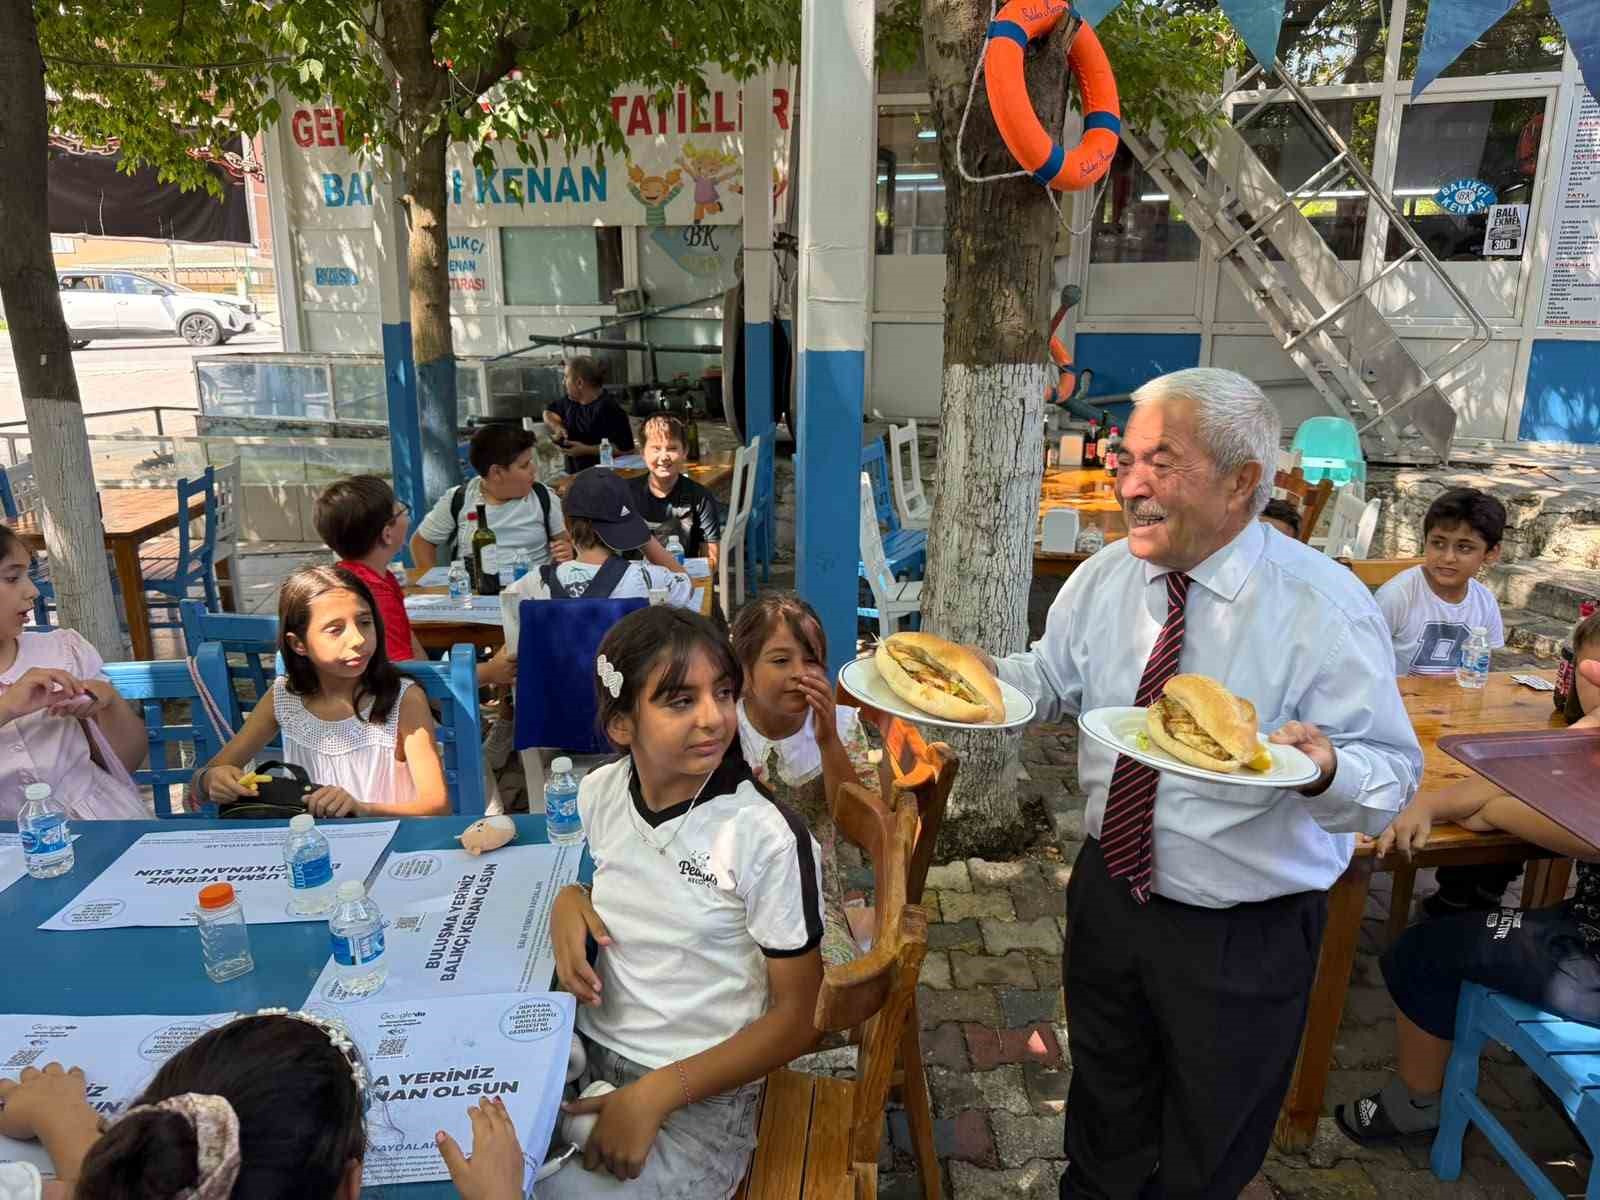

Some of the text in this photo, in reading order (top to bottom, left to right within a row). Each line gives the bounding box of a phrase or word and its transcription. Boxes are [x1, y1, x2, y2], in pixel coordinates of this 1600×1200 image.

[474, 166, 607, 204] KENAN
[1442, 198, 1485, 214] KENAN
[1493, 239, 1511, 250] 300
[449, 259, 476, 273] ENAN
[134, 867, 198, 878] OLSUN
[200, 865, 265, 875] KENAN
[425, 874, 477, 969] BULUŞMA YERİNİZ
[440, 862, 499, 981] BALIKÇI KENAN OLSUN
[399, 1064, 495, 1085] YERİNİZ
[432, 1080, 520, 1098] OLSUN
